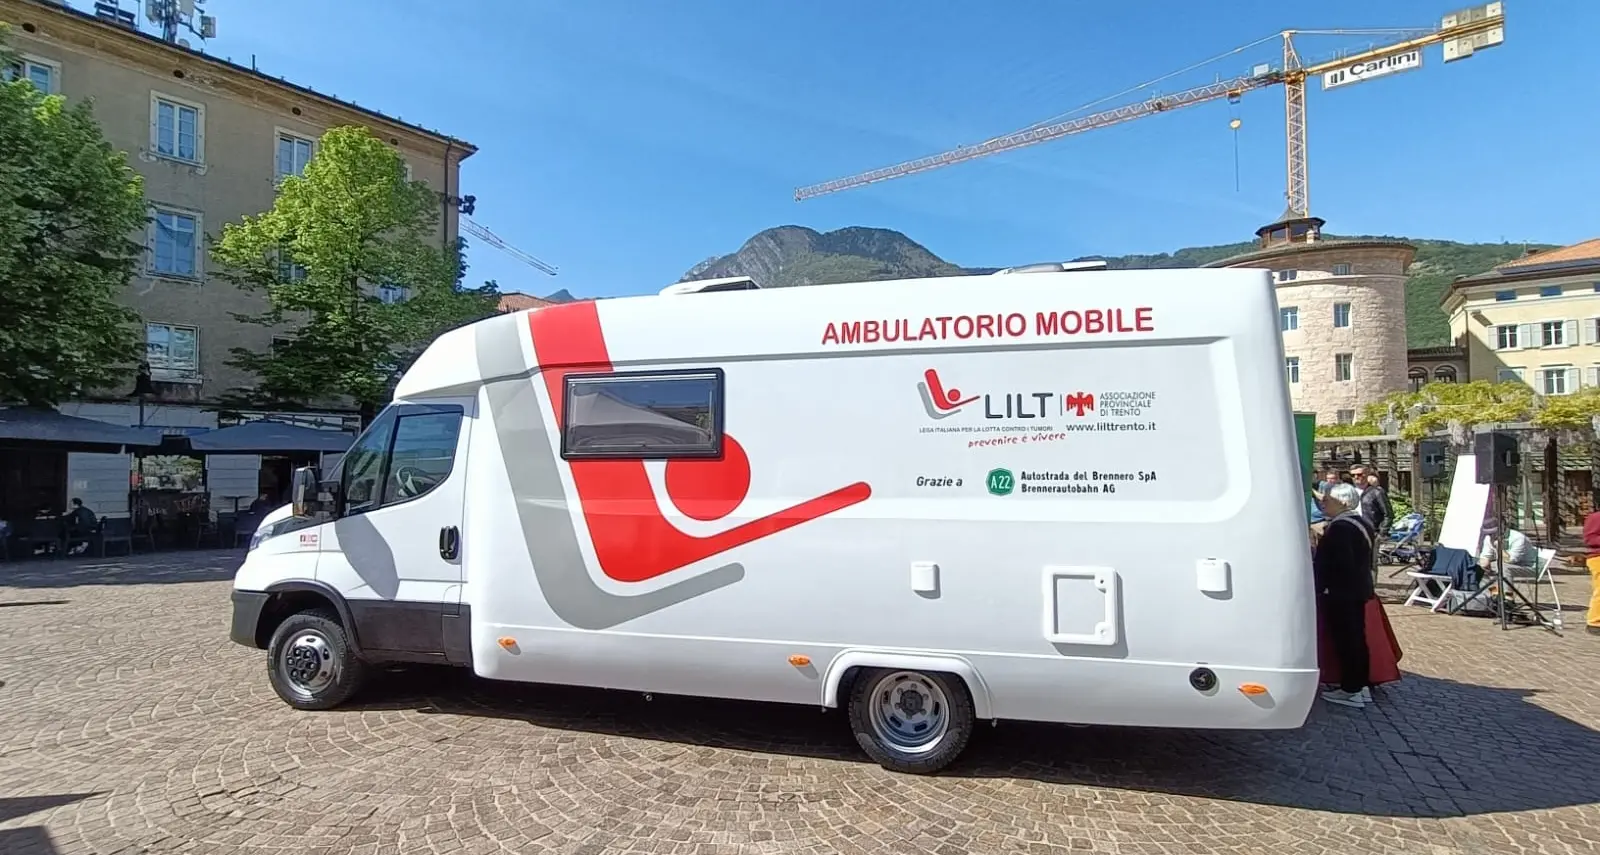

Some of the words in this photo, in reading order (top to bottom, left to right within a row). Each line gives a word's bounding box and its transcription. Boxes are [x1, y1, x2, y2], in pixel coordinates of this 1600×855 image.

[1349, 51, 1416, 76] Carlini
[822, 312, 1027, 345] AMBULATORIO
[1036, 307, 1155, 336] MOBILE
[1100, 391, 1156, 400] ASSOCIAZIONE
[985, 393, 1054, 419] LILT
[1100, 400, 1151, 408] PROVINCIALE
[1066, 422, 1156, 431] www.lilttrento.it
[968, 436, 1018, 447] prevenire
[1032, 432, 1066, 441] vivere
[916, 476, 953, 487] Grazie
[956, 478, 963, 486] a
[991, 475, 1010, 489] A22
[1021, 471, 1070, 480] Autostrada
[1073, 471, 1088, 480] del
[1092, 471, 1135, 480] Brennero
[1138, 471, 1157, 482] SpA
[1021, 484, 1099, 493] Brennerautobahn
[1103, 484, 1116, 493] AG
